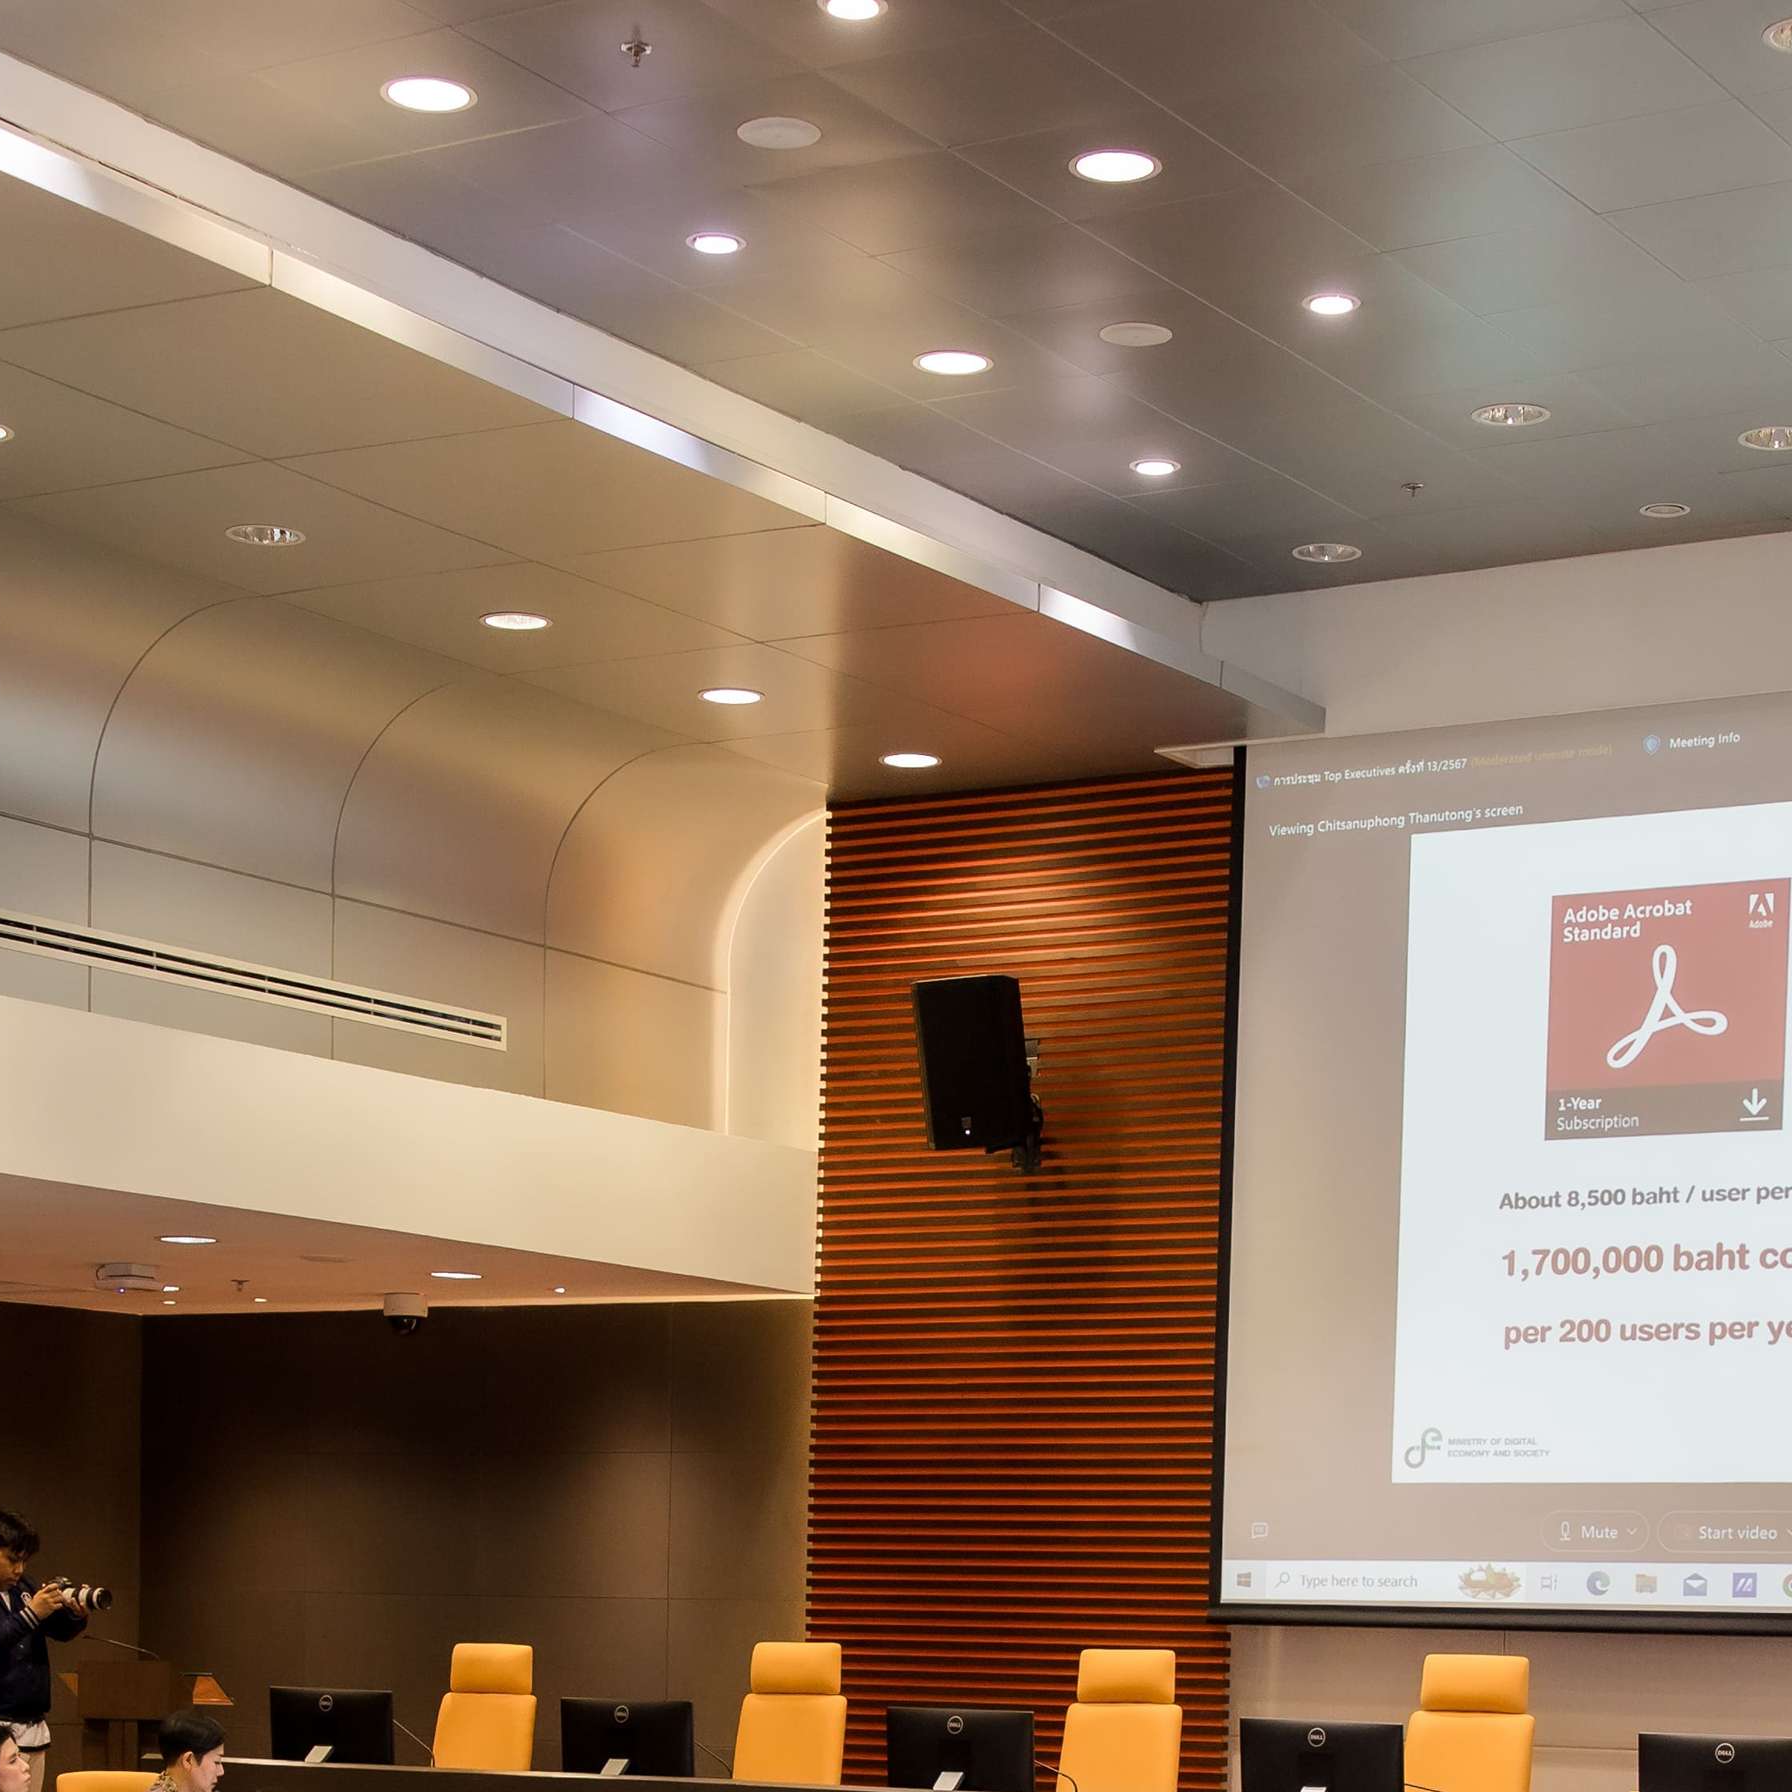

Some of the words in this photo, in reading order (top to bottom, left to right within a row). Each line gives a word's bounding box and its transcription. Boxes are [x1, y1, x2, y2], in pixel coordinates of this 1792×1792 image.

[1669, 735, 1715, 750] Meeting
[1718, 731, 1741, 745] Info
[1324, 770, 1342, 784] Top
[1344, 765, 1396, 780] Executives
[1426, 758, 1468, 773] 13/2567
[1269, 822, 1314, 837] Viewing
[1317, 814, 1405, 833] Chitsanuphong
[1408, 807, 1483, 825] Thanutong's
[1484, 803, 1524, 818] screen
[1563, 907, 1620, 924] Adobe
[1623, 898, 1693, 919] Acrobat
[1562, 922, 1642, 943] Standard
[1558, 1097, 1602, 1111] 1-Year
[1556, 1114, 1640, 1132] Subscription
[1499, 1190, 1562, 1210] About
[1567, 1188, 1626, 1211] 8,500
[1631, 1186, 1680, 1206] baht
[1701, 1187, 1750, 1203] user
[1502, 1243, 1664, 1281] 1,700,000
[1672, 1241, 1750, 1272] baht
[1503, 1324, 1552, 1350] per
[1558, 1318, 1612, 1343] 200
[1619, 1319, 1701, 1342] users
[1708, 1319, 1760, 1346] per
[1447, 1437, 1488, 1446] MINISTRY
[1504, 1437, 1537, 1446] DIGITAL
[1492, 1449, 1511, 1458] AND
[1512, 1448, 1552, 1458] SOCIETY
[1581, 1525, 1619, 1540] Mute
[1699, 1525, 1733, 1540] Start
[1737, 1525, 1778, 1540] video
[1299, 1573, 1329, 1589] Type
[1330, 1574, 1359, 1588] here
[1361, 1576, 1375, 1588] to
[1377, 1576, 1418, 1588] search
